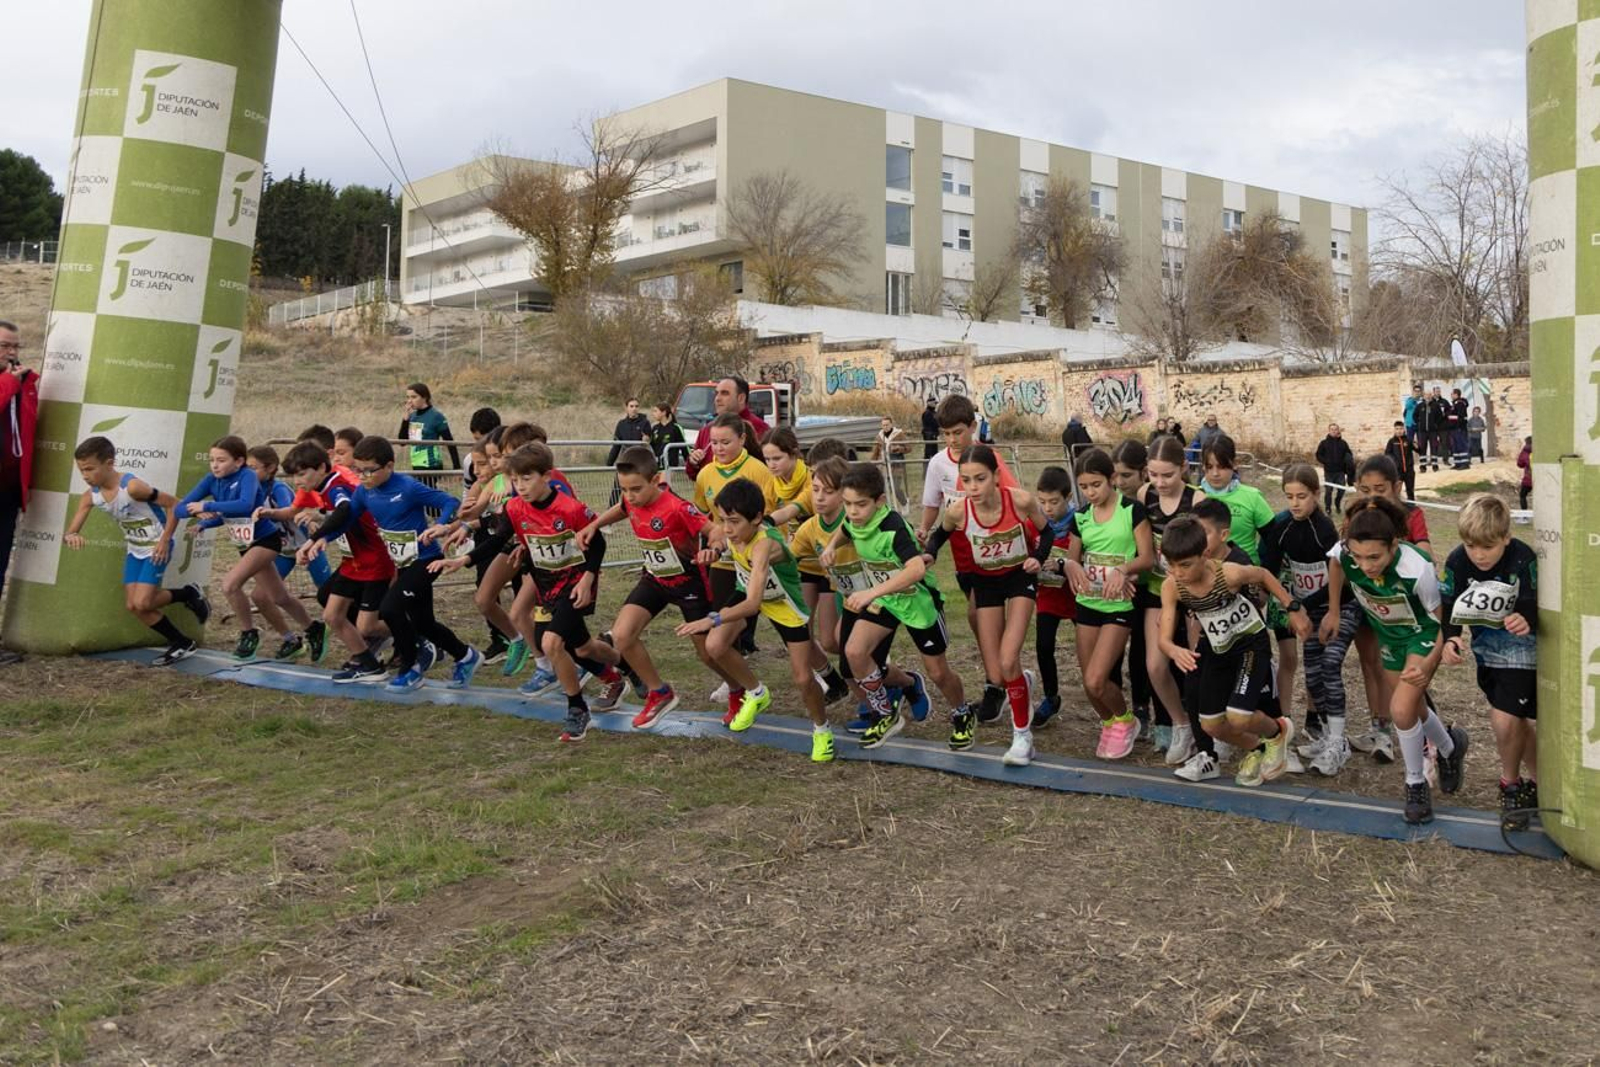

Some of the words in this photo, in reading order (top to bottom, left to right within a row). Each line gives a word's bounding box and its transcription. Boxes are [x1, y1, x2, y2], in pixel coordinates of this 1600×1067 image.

[158, 92, 220, 111] DIPUTACIÓN
[156, 103, 171, 112] DE
[173, 104, 199, 117] JAÉN
[131, 267, 195, 284] DIPUTACIÓN
[130, 279, 145, 288] DE
[147, 280, 173, 292] JAÉN
[119, 458, 147, 469] JAÉN
[389, 542, 406, 556] 67
[536, 541, 567, 557] 117
[979, 541, 1013, 557] 227
[1296, 573, 1324, 590] 307
[1460, 590, 1516, 612] 4308
[1208, 602, 1250, 636] 4309
